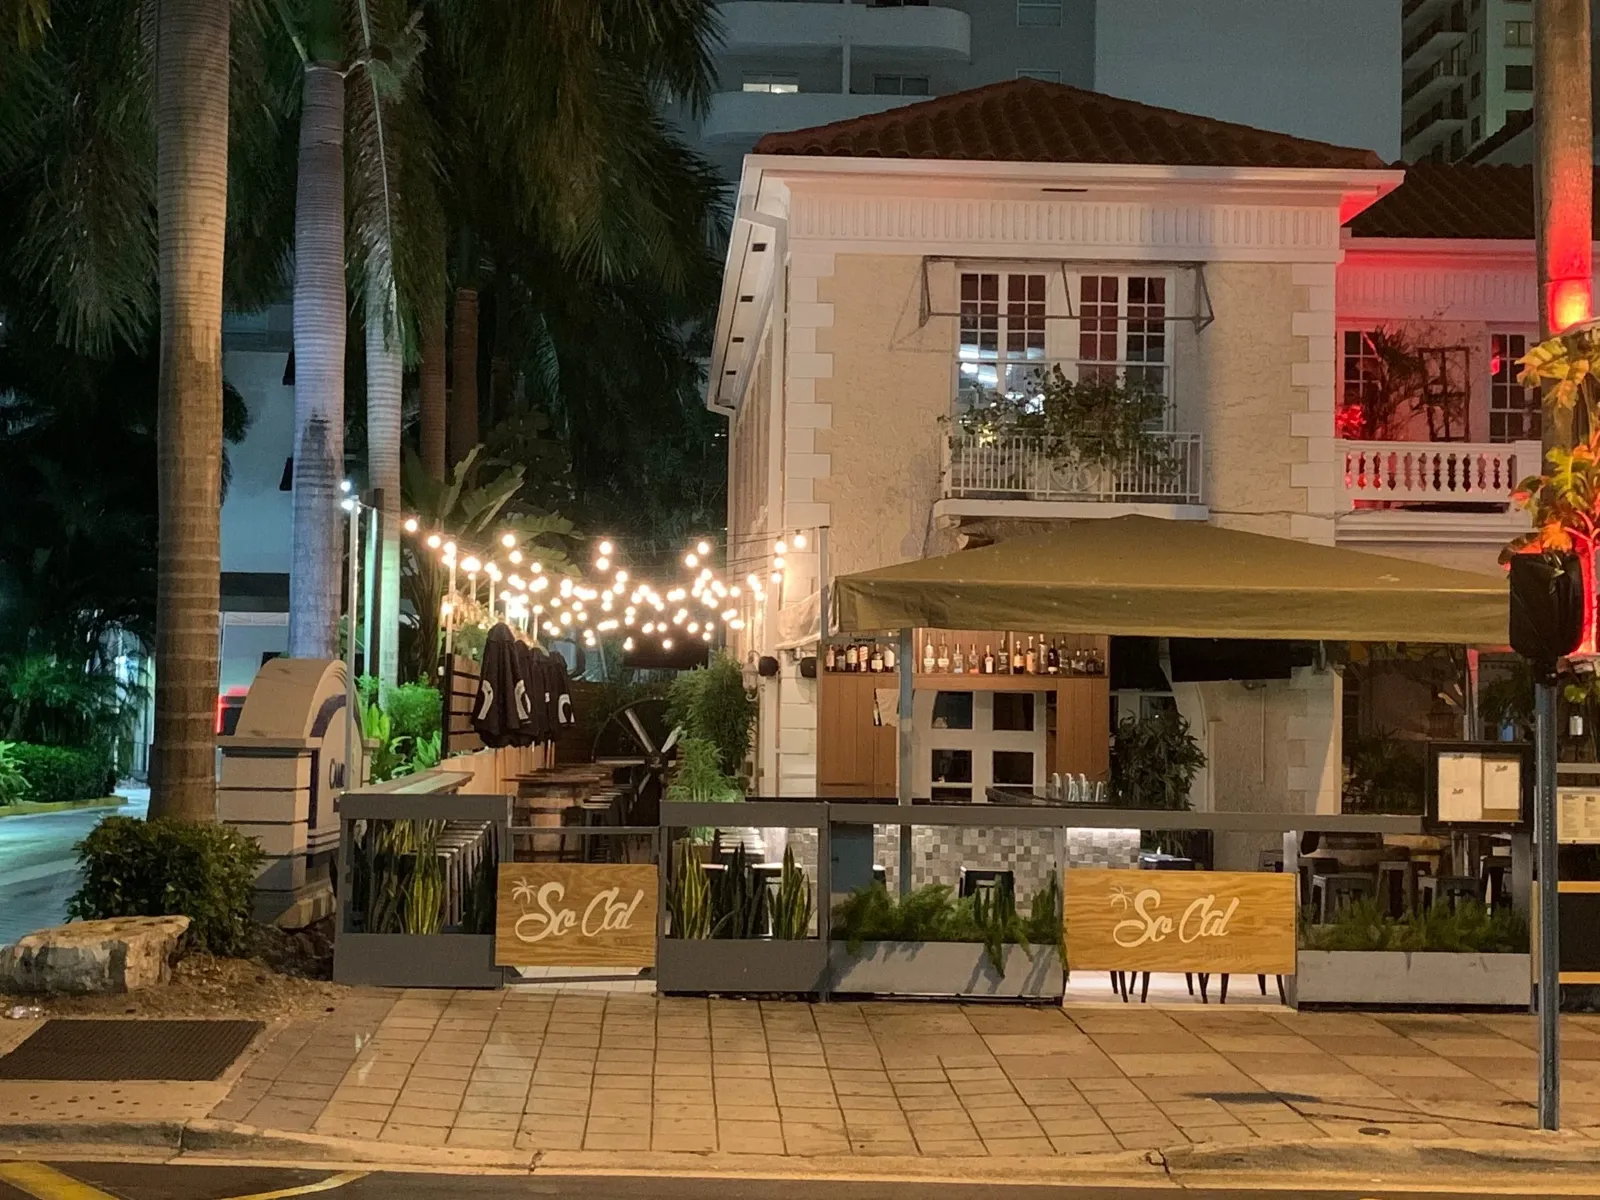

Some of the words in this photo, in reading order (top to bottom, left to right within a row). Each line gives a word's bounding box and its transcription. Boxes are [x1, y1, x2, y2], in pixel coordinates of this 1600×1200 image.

[514, 881, 579, 942] So
[581, 886, 645, 937] Cal
[1113, 889, 1175, 948] So
[1179, 894, 1240, 944] Cal
